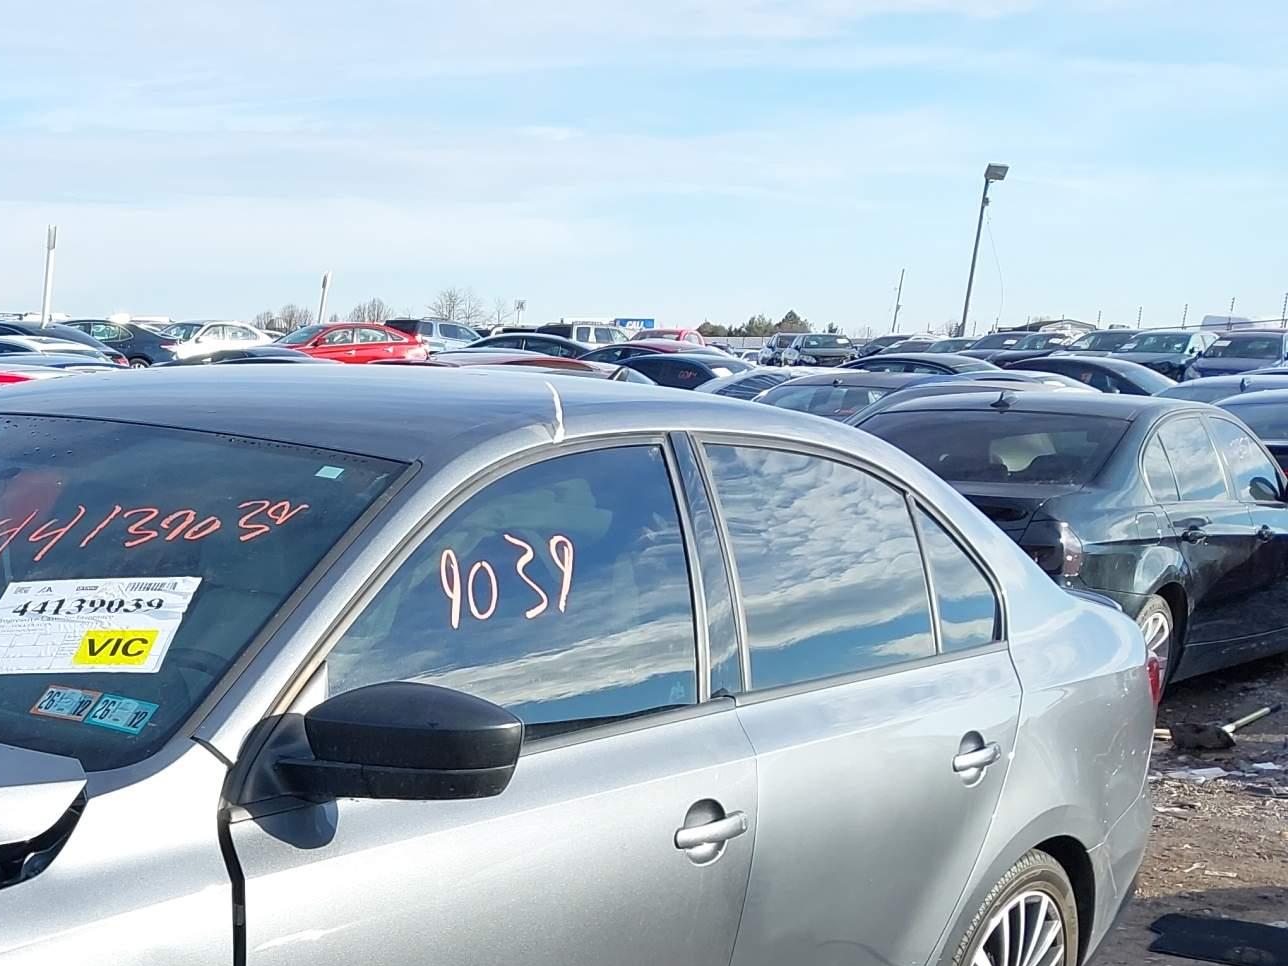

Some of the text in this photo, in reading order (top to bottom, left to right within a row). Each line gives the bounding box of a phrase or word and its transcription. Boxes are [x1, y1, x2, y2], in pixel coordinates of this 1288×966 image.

[440, 534, 574, 629] 9039
[12, 597, 164, 617] 44139039
[87, 637, 148, 657] VIC
[38, 691, 91, 717] 26 12
[92, 699, 148, 728] 26 12
